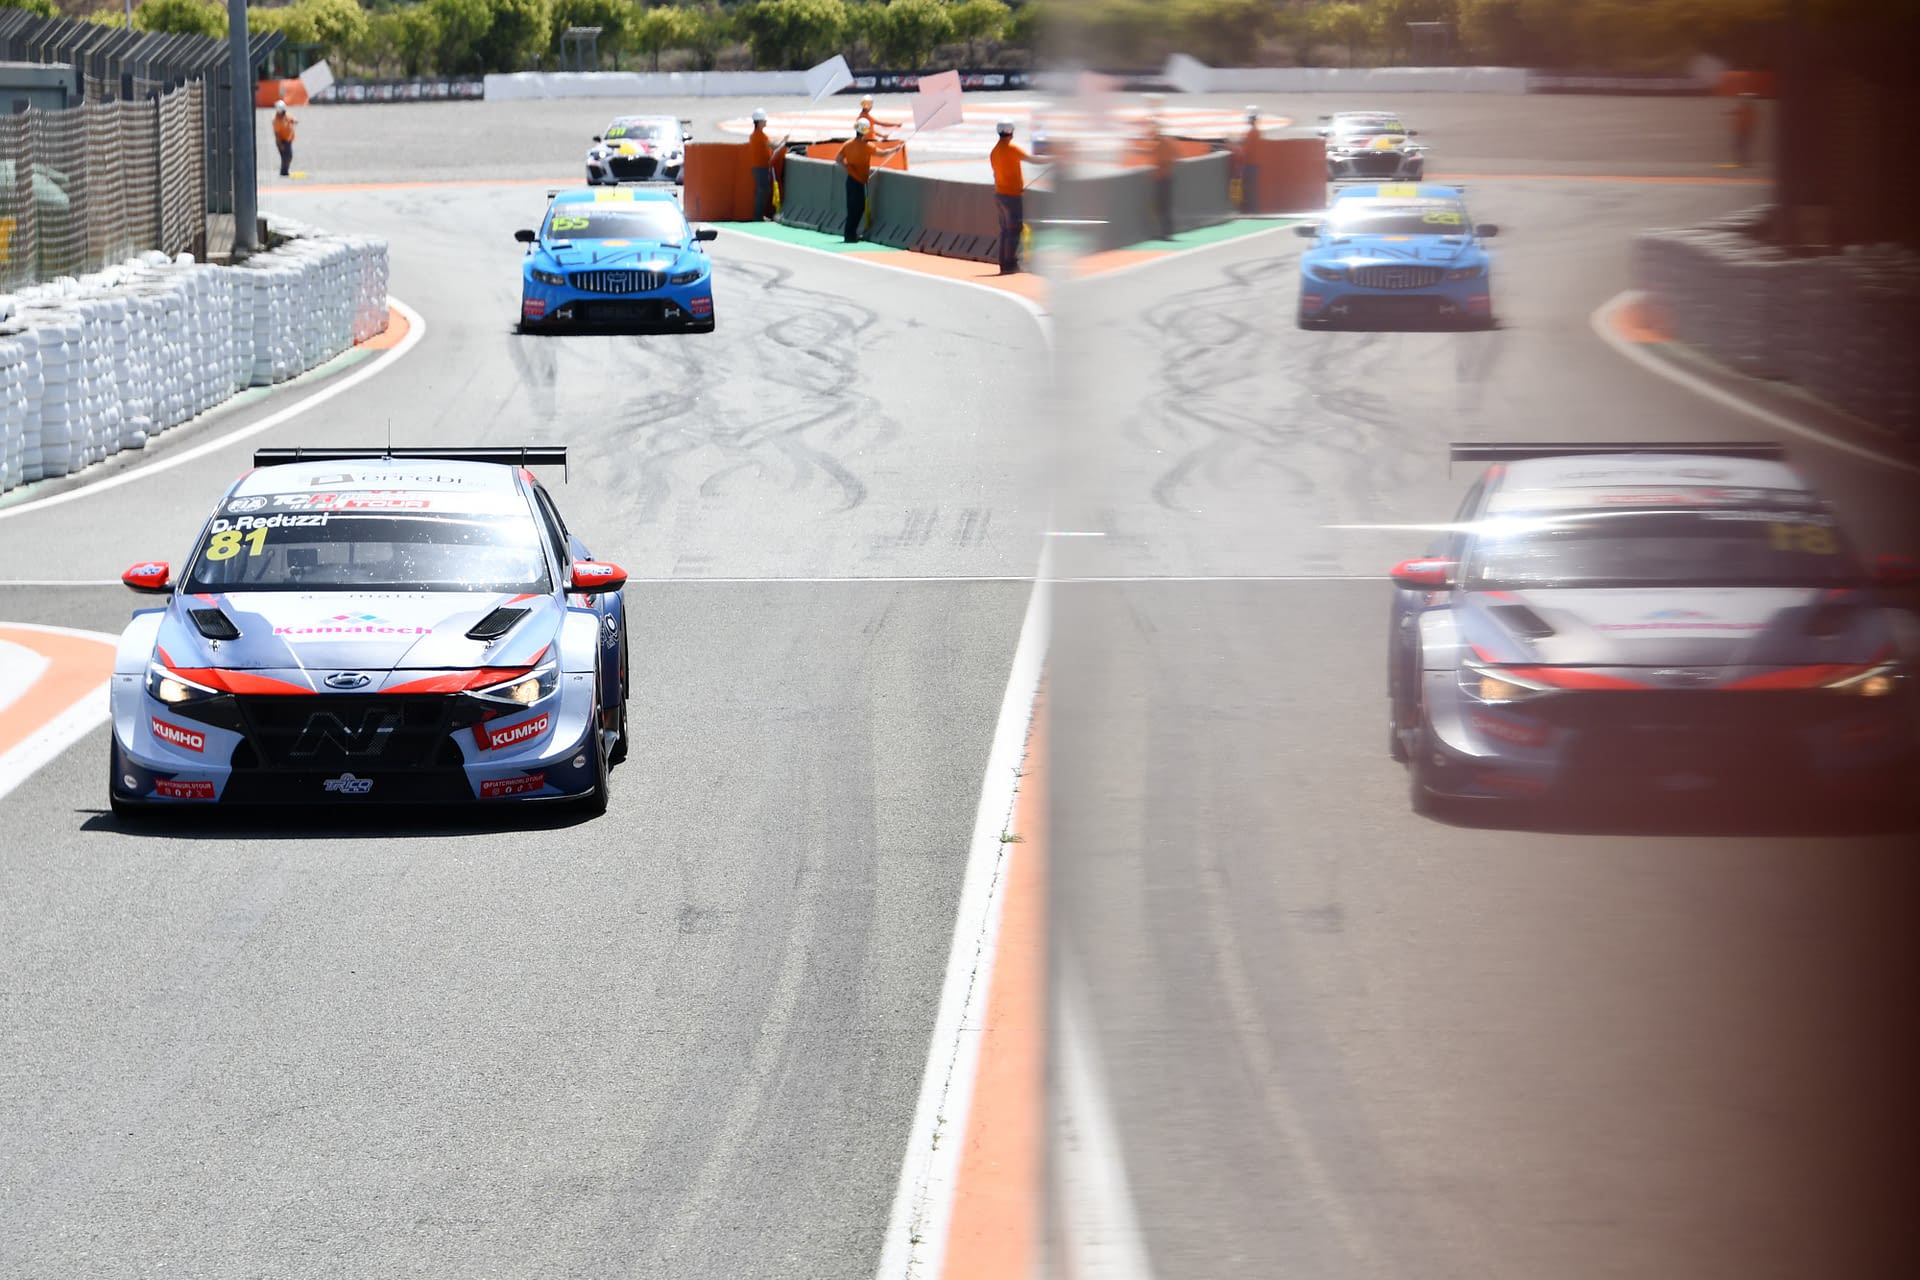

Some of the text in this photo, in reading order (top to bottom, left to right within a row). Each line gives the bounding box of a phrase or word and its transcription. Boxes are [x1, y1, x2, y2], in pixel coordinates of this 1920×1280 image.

[552, 216, 590, 231] 155
[273, 494, 337, 506] TCR
[352, 499, 425, 509] TOUR
[206, 527, 269, 561] 81
[274, 625, 433, 636] Kamatech
[152, 720, 203, 748] KUMHO
[491, 717, 548, 746] KUMHO
